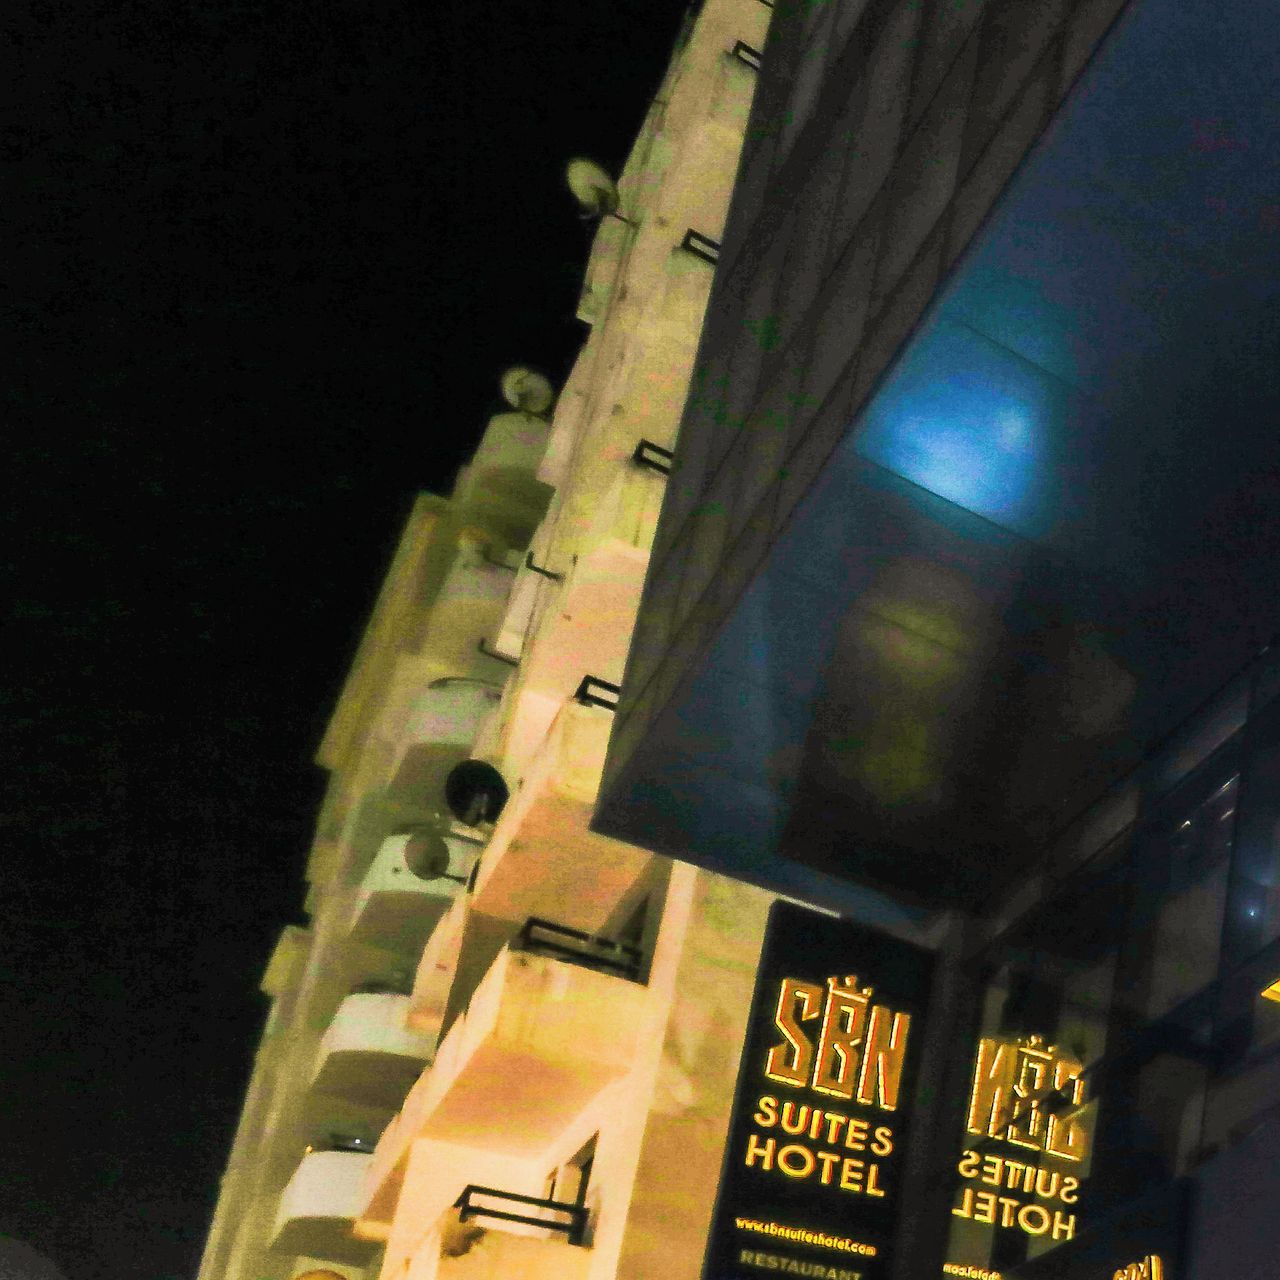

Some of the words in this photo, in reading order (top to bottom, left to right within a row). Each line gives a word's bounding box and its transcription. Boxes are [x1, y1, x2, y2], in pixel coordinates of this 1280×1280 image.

[765, 976, 911, 1111] SBN
[754, 1096, 893, 1156] SUITES
[745, 1134, 885, 1196] HOTEL
